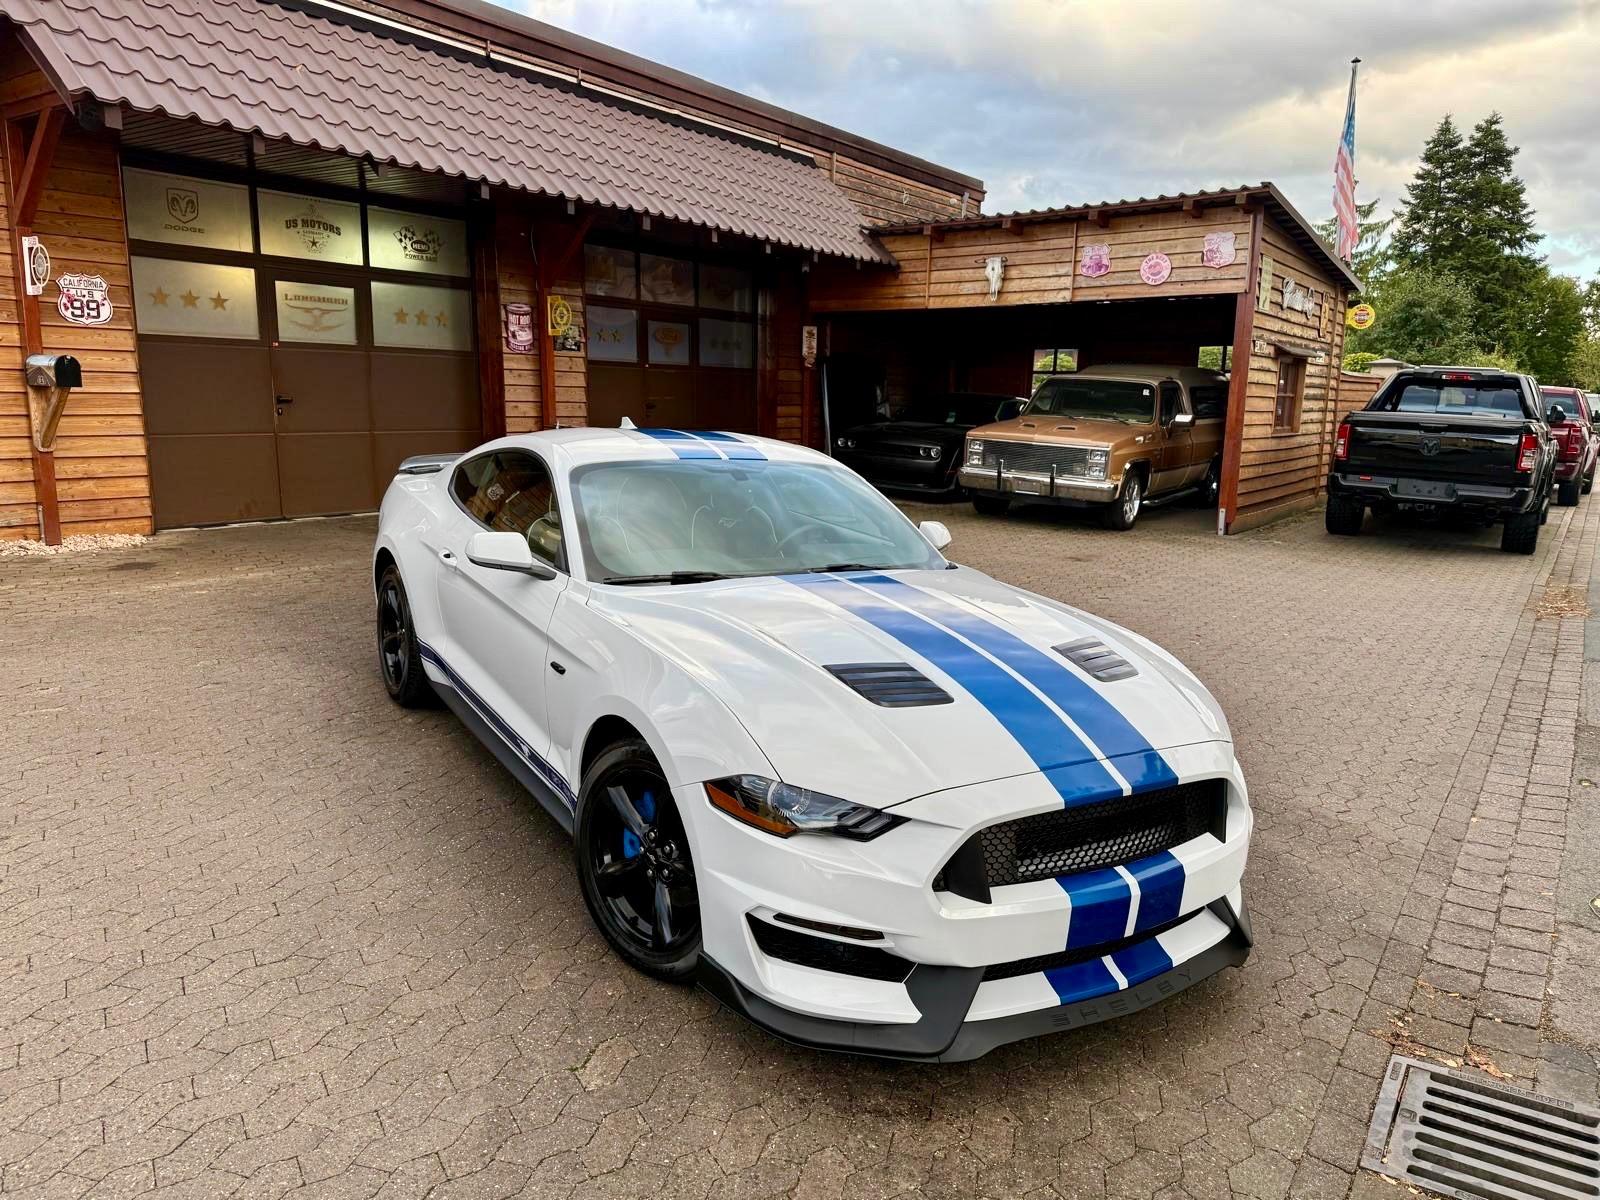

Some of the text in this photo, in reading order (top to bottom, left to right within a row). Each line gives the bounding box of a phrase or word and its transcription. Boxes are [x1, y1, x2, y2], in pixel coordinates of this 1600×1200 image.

[164, 224, 205, 233] DODGE
[285, 218, 342, 236] US MOTORS
[63, 278, 104, 289] CALIFORNIA
[70, 299, 101, 318] 99
[1050, 969, 1192, 1027] SHELBY
